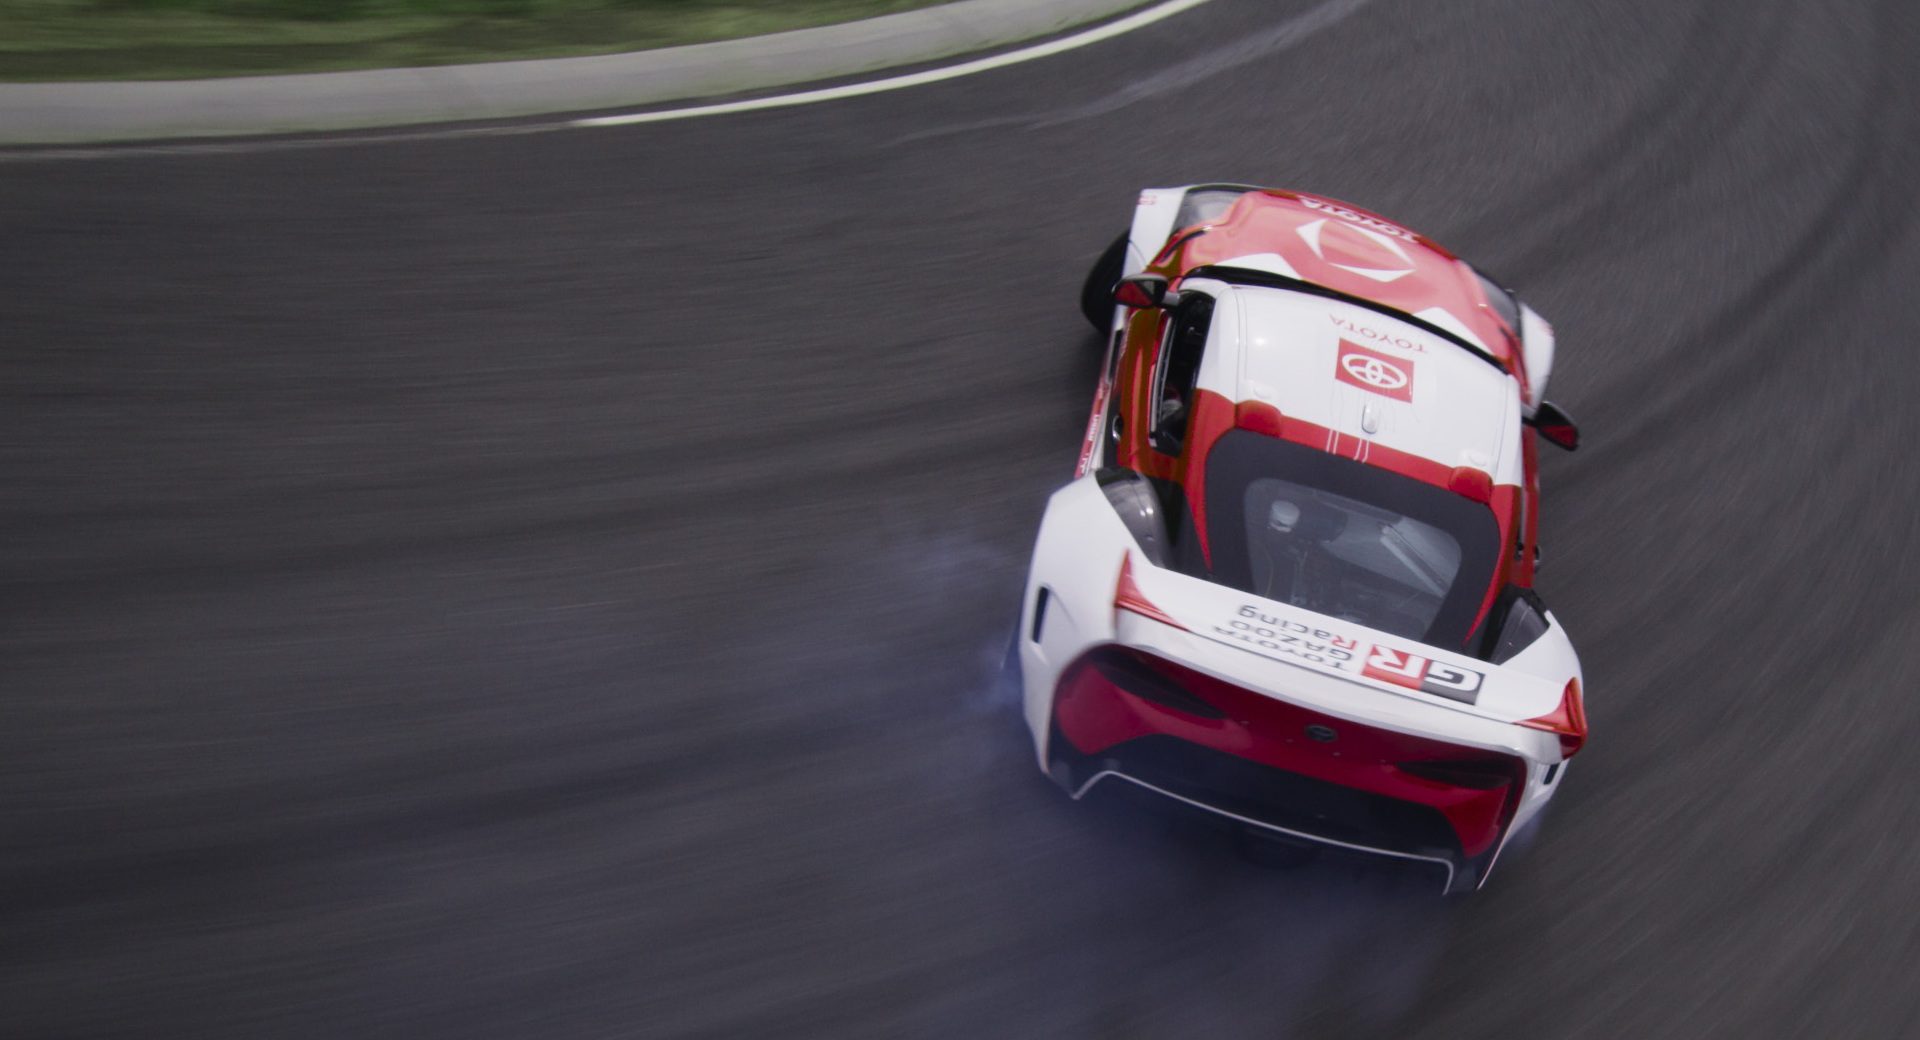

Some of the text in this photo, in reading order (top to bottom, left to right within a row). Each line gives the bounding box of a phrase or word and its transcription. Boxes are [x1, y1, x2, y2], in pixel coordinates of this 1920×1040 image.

[1297, 195, 1421, 243] TOYOTA
[1329, 313, 1428, 354] TOYOTA
[1213, 626, 1351, 672] TOYOTA
[1229, 620, 1353, 661] GAZOO
[1238, 605, 1357, 650] Racing
[1367, 645, 1481, 691] GR
